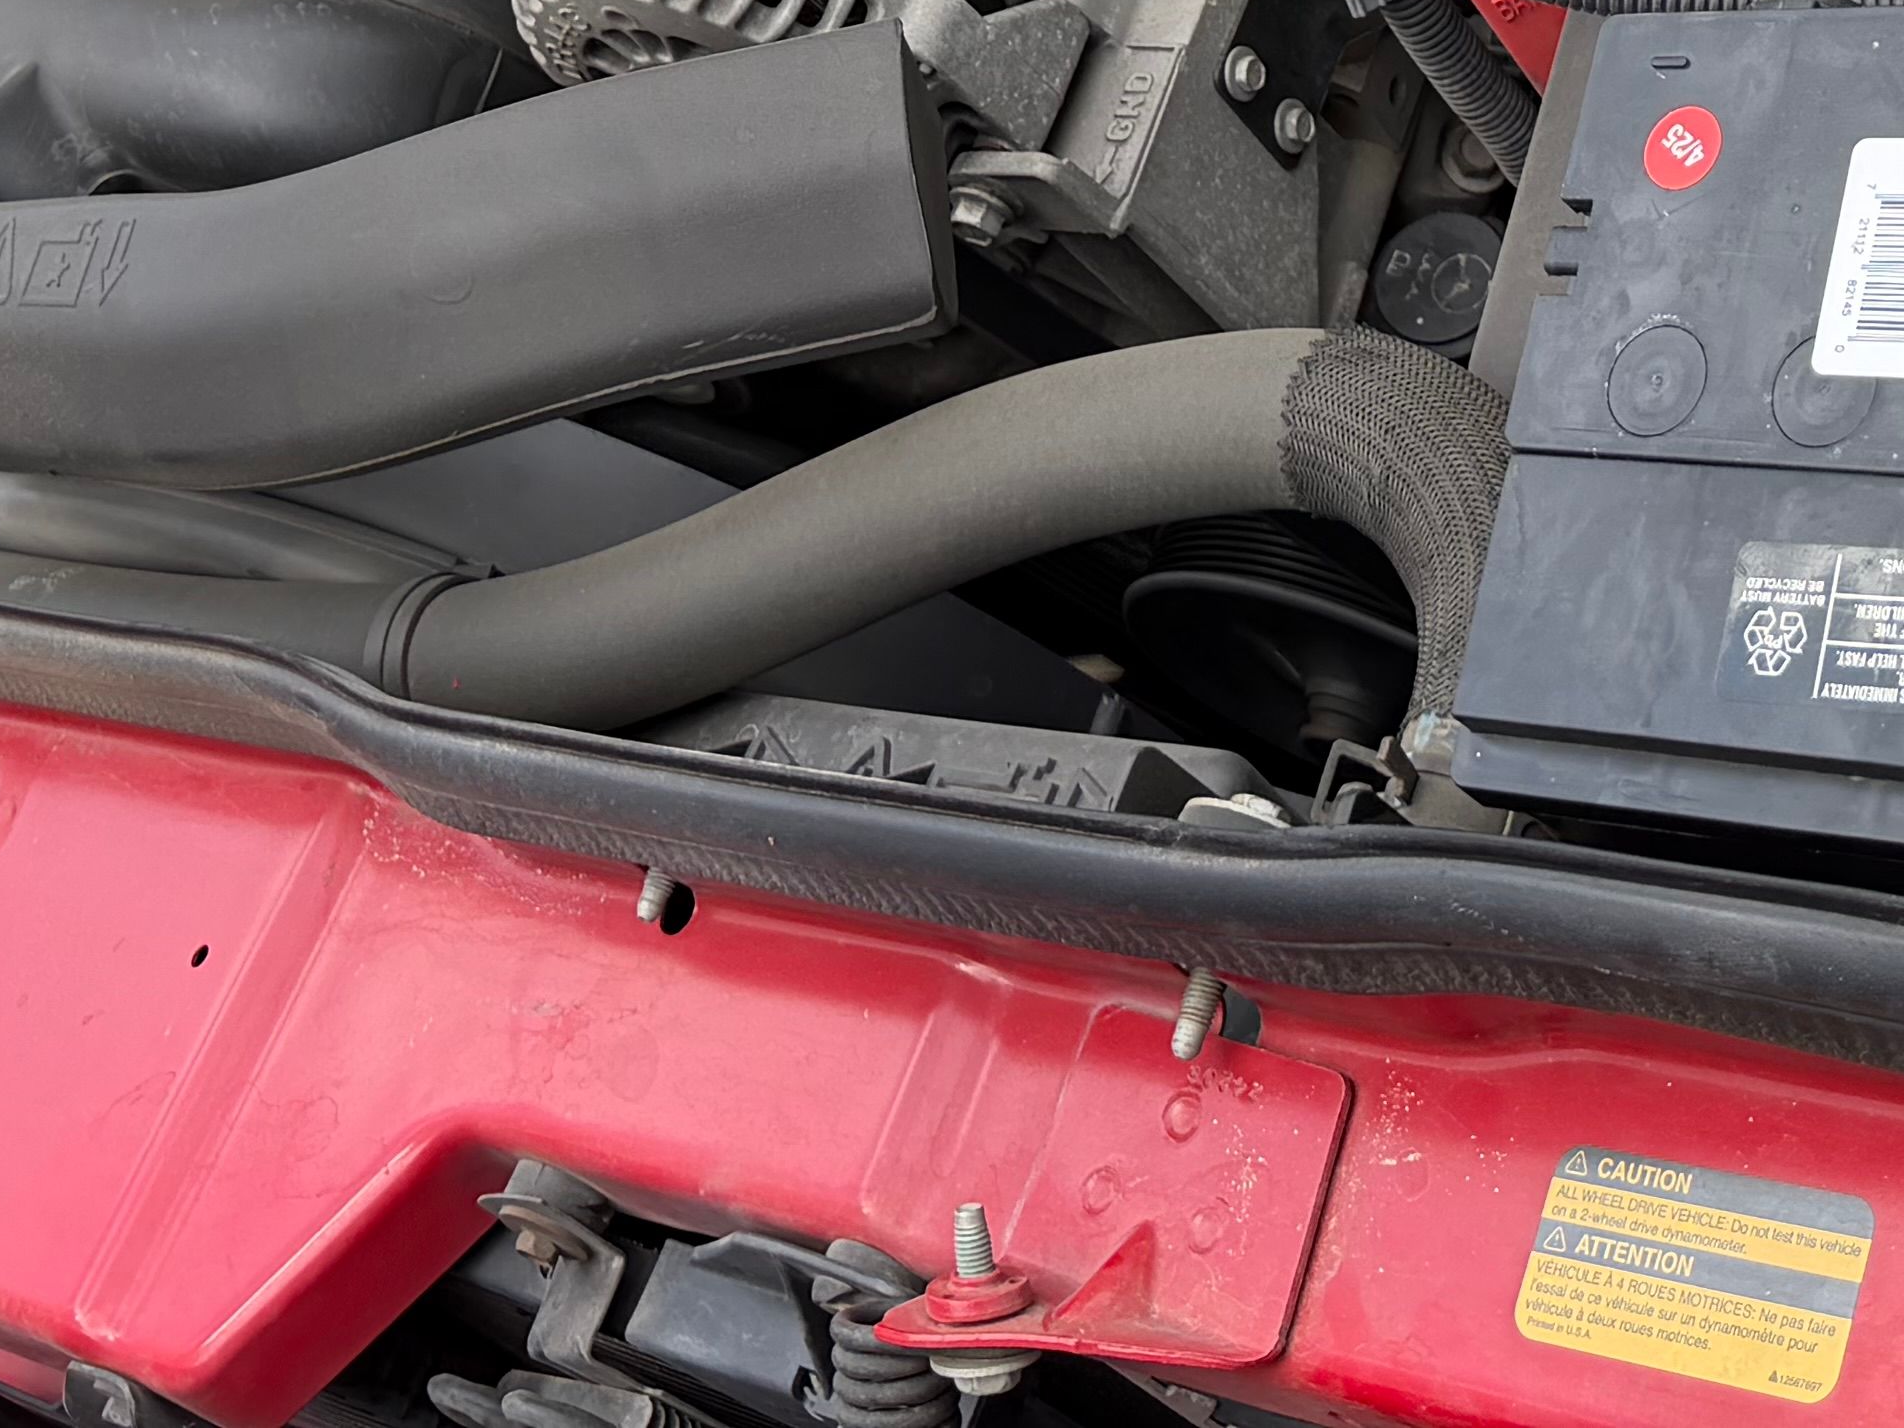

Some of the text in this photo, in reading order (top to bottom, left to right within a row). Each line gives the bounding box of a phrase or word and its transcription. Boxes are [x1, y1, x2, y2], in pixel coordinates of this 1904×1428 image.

[1105, 73, 1154, 142] GND
[1661, 124, 1705, 167] 4/25
[1841, 279, 1857, 316] 82145
[1746, 576, 1825, 592] BE RECYCLED
[1772, 591, 1825, 606] BATTERY
[1873, 623, 1897, 638] THE
[1836, 651, 1866, 666] FAST.
[1867, 653, 1897, 669] HELP
[1821, 682, 1897, 703] IMMEDIATELY
[1597, 1157, 1693, 1195] CAUTION
[1551, 1204, 1748, 1255] on a 2-wheel drive dynamometer.
[1556, 1184, 1862, 1257] ALL WHEEL DRIVE VEHICLE: Do not test this vehicle
[1575, 1233, 1694, 1277] ATTENTION
[1530, 1278, 1568, 1297] l'essai
[1569, 1287, 1585, 1302] de
[1587, 1293, 1602, 1305] ce
[1606, 1296, 1655, 1317] véhicule
[1657, 1309, 1677, 1321] sur
[1680, 1314, 1696, 1326] un
[1787, 1337, 1818, 1353] pour
[1537, 1258, 1602, 1285] VÉHICULE
[1616, 1279, 1624, 1289] 4
[1627, 1279, 1676, 1302] ROUES
[1678, 1290, 1755, 1320] MOTRICES:
[1758, 1307, 1778, 1324] Ne
[1780, 1316, 1804, 1330] pas
[1807, 1318, 1836, 1336] faire
[1525, 1298, 1573, 1319] véhicule
[1587, 1311, 1616, 1329] deux
[1619, 1320, 1654, 1338] roues
[1656, 1327, 1712, 1351] motrices.
